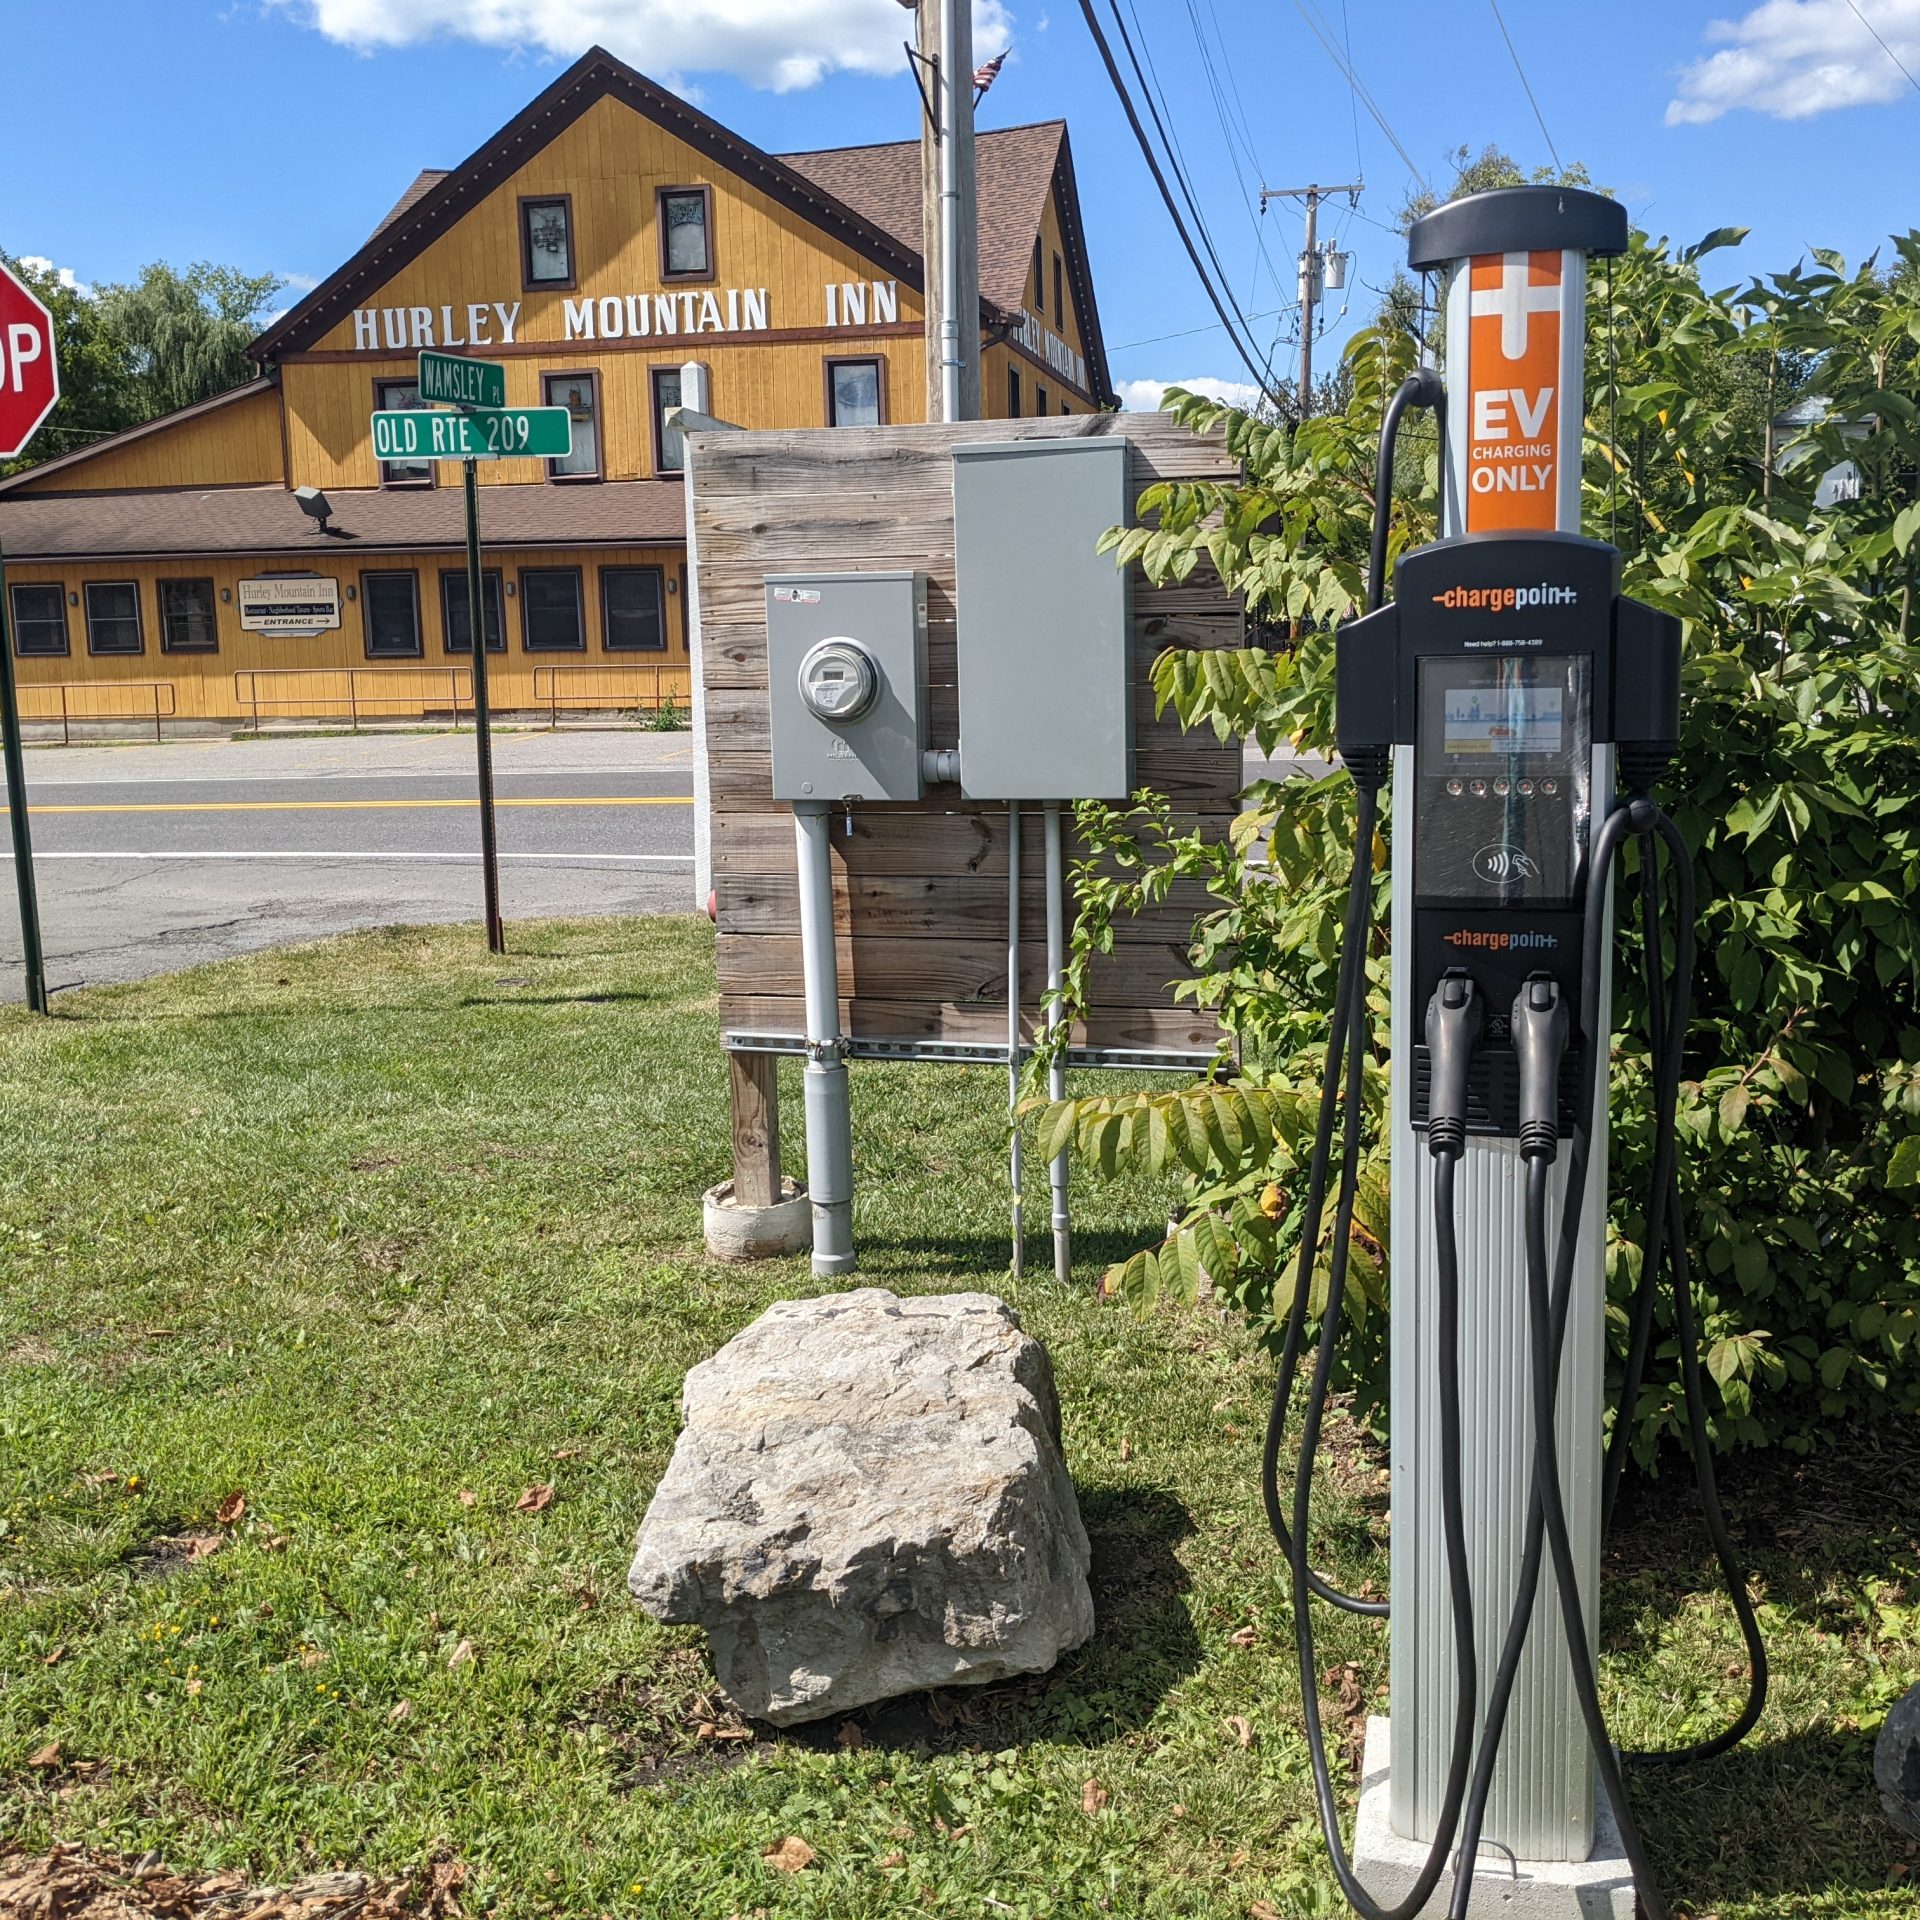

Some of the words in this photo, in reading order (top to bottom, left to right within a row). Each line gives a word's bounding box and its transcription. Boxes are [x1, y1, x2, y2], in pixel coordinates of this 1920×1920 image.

[353, 301, 521, 351] HURLEY
[563, 287, 767, 341] MOUNTAIN
[825, 280, 897, 327] INN
[424, 358, 484, 401] WAMSLEY
[492, 385, 502, 404] PL
[1473, 387, 1554, 441] EV
[377, 417, 417, 453] OLD
[431, 416, 472, 452] RTE
[486, 415, 530, 451] 209
[1472, 443, 1551, 460] CHARGING
[1471, 463, 1553, 493] ONLY
[242, 584, 271, 601] Hurley
[273, 583, 315, 599] Mountain
[318, 583, 334, 597] Inn
[263, 618, 314, 626] ENTRANCE
